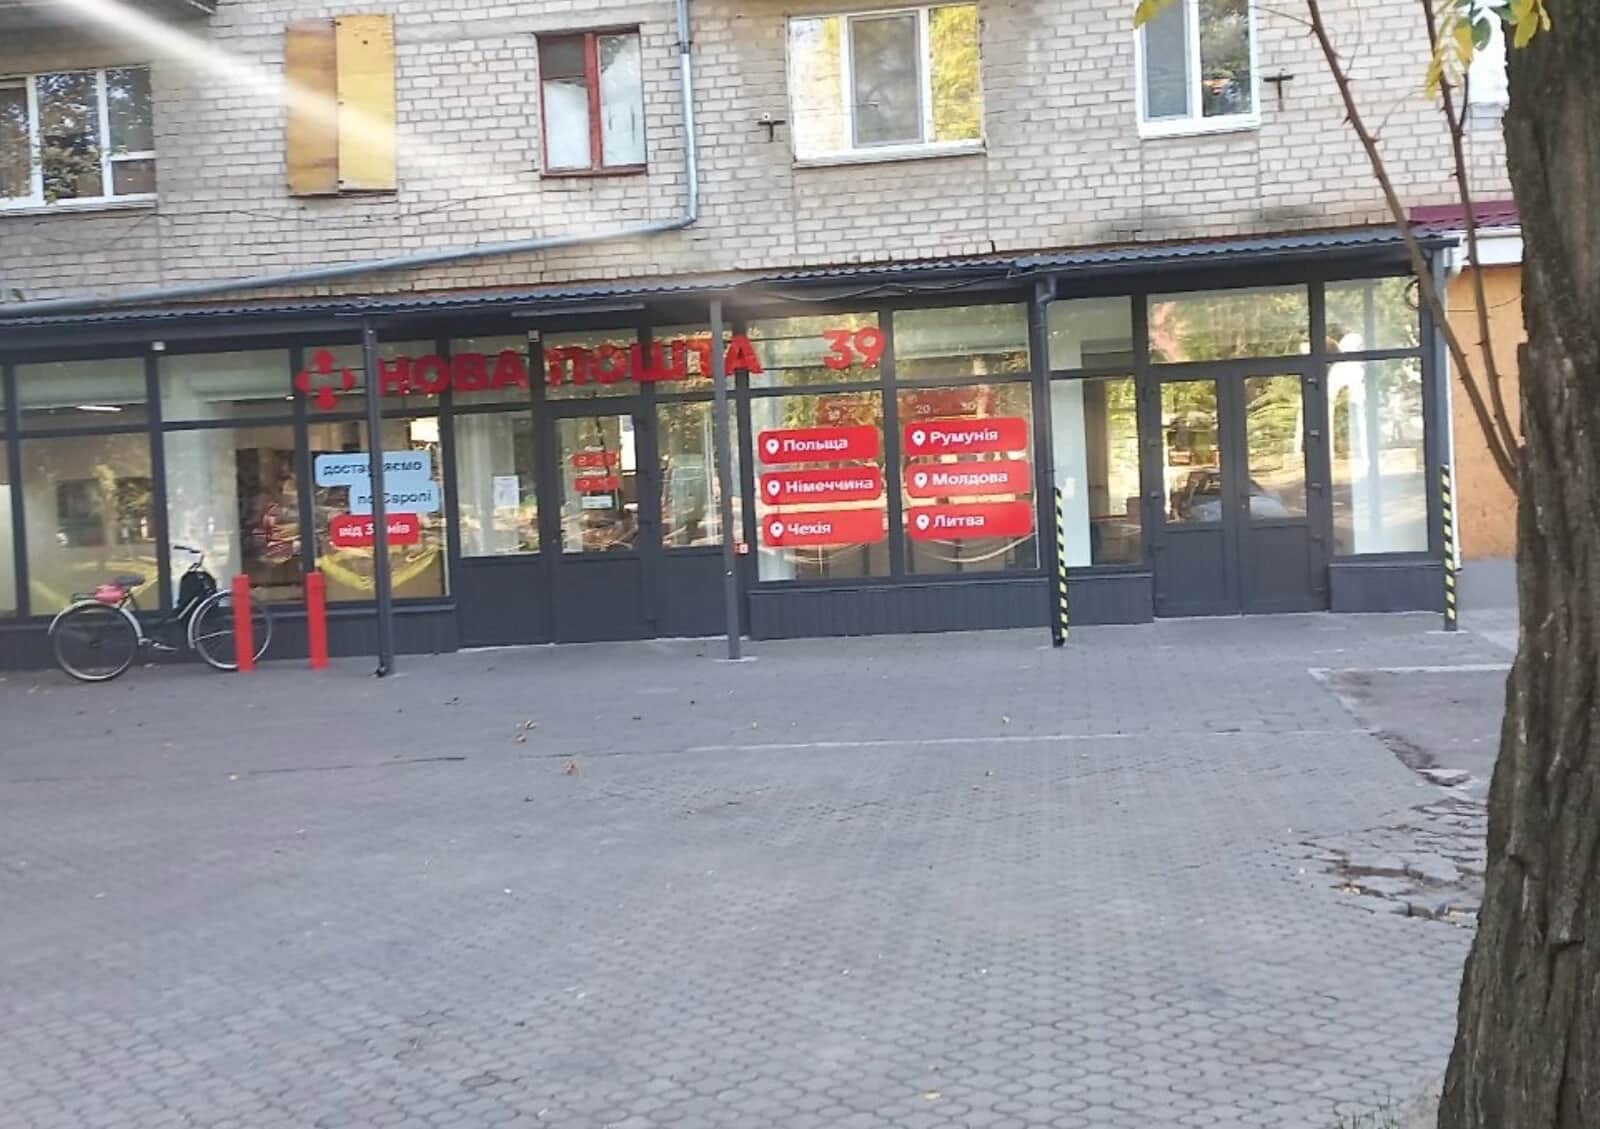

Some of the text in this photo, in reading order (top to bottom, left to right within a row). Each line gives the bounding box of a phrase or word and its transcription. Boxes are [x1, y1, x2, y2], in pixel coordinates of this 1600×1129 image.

[379, 327, 885, 395] НОВА ПОШТА 39
[784, 437, 848, 454] Польща
[930, 430, 998, 446] Румунія
[932, 470, 1008, 486] Молдова
[786, 478, 874, 495] Німеччина
[788, 522, 832, 537] Чехія
[934, 514, 984, 529] Литва
